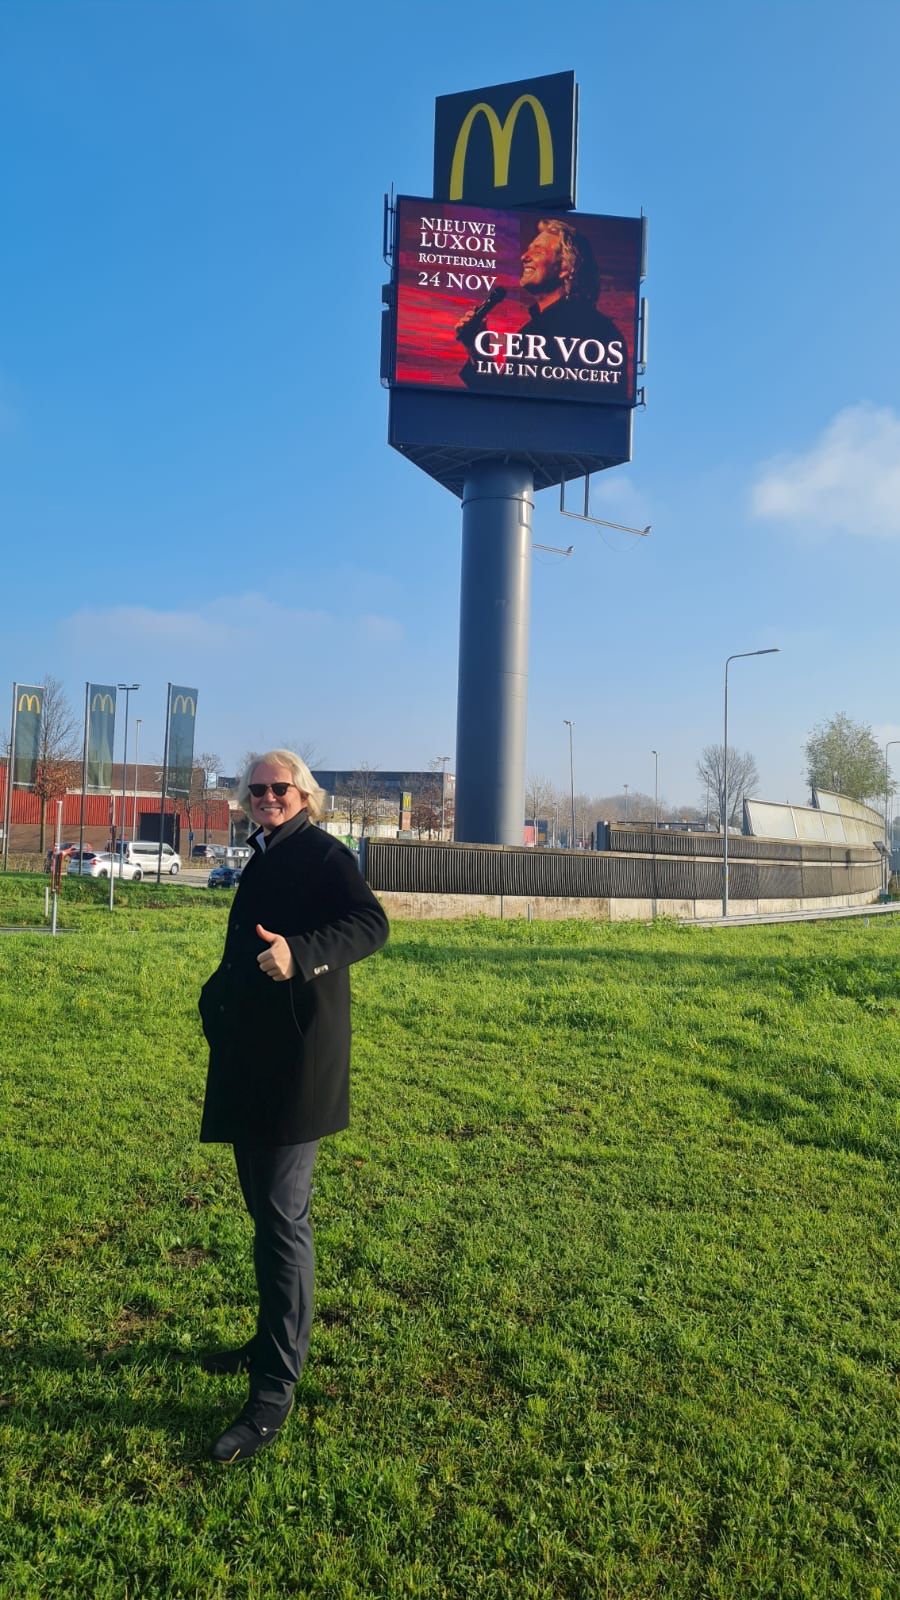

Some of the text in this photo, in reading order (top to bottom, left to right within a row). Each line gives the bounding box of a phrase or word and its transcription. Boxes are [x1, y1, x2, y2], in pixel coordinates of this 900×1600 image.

[420, 217, 496, 236] NIEUWE
[420, 232, 496, 252] LUXOR
[418, 252, 497, 269] ROTTERDAM
[418, 271, 497, 292] 24 NOV
[474, 330, 623, 366] GER VOS
[476, 360, 621, 383] LIVE IN CONCERT
